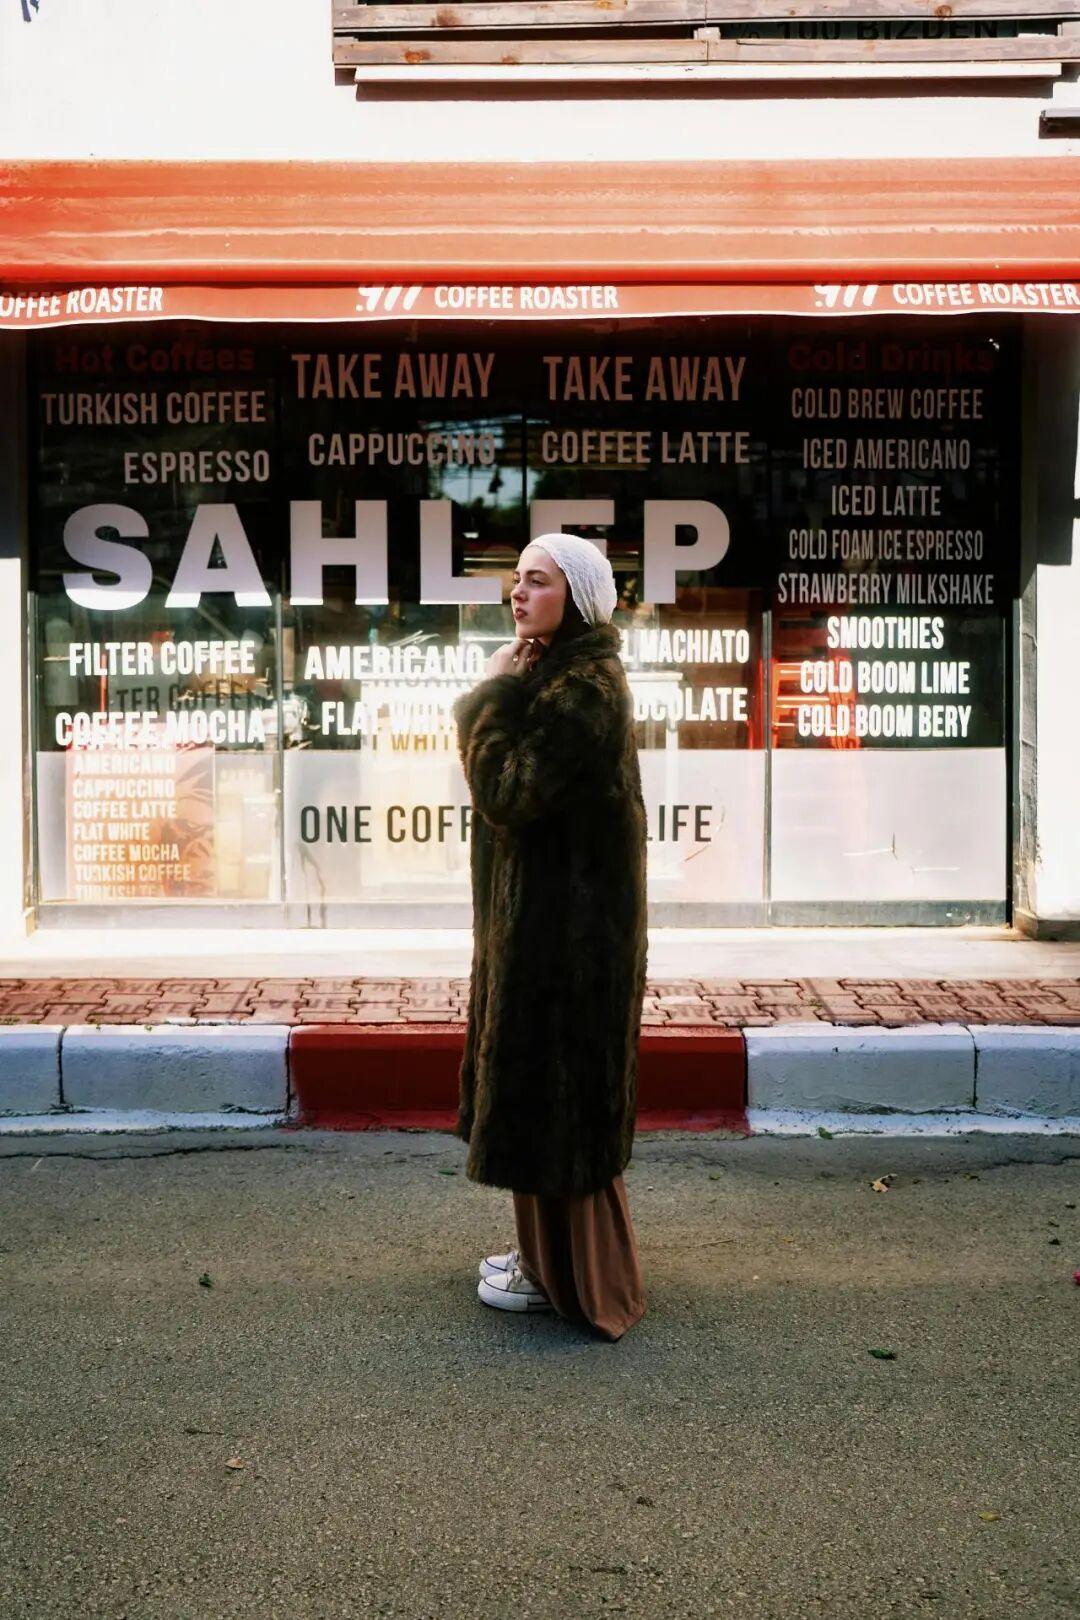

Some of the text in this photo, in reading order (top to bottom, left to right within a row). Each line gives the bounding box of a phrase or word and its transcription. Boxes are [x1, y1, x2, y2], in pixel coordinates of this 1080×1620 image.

[0, 286, 164, 318] OFFEE ROASTER
[434, 285, 514, 309] COFFEE
[520, 285, 619, 310] ROASTER
[892, 283, 975, 306] COFFEE
[977, 283, 1080, 306] ROASTER
[56, 340, 256, 373] Hot Coffees
[786, 340, 995, 373] Cold Drinks
[291, 352, 496, 399] TAKE AWAY
[542, 356, 747, 401] TAKE AWAY
[40, 391, 267, 425] TURKISH COFFEE
[791, 387, 984, 419] COLD BREW COFFEE
[308, 432, 496, 466] CAPPUCCINO
[541, 431, 750, 464] COFFEE LATTE
[803, 438, 971, 470] ICED AMERICANO
[124, 449, 270, 484] ESPRESSO
[831, 485, 942, 516] ICED LATTE
[789, 529, 984, 561] COLD FOAM ICE ESPRESSO
[777, 572, 994, 605] STRAWBERRY MILKSHAKE
[638, 629, 750, 664] MACHIATO
[826, 615, 945, 650] SMOOTHIES
[69, 640, 256, 676] FILTER COFFEE
[304, 645, 485, 680] AMERICANO
[799, 660, 971, 694] COLD BOOM LIME
[632, 686, 749, 722] OCOLATE
[55, 711, 159, 747] COFFEE
[165, 709, 266, 744] MOCHA
[798, 704, 972, 738] COLD BOOM BERY
[73, 754, 177, 774] AMERICANO
[72, 778, 175, 800] CAPPUCCINO
[72, 801, 177, 819] COFFEE LATTE
[301, 805, 473, 843] ONE COFF
[646, 805, 713, 842] IFE
[72, 822, 150, 841] FLAT WHITE
[72, 844, 180, 862] COFFEE MOCHA
[74, 864, 191, 883] TURKISH COFFEE
